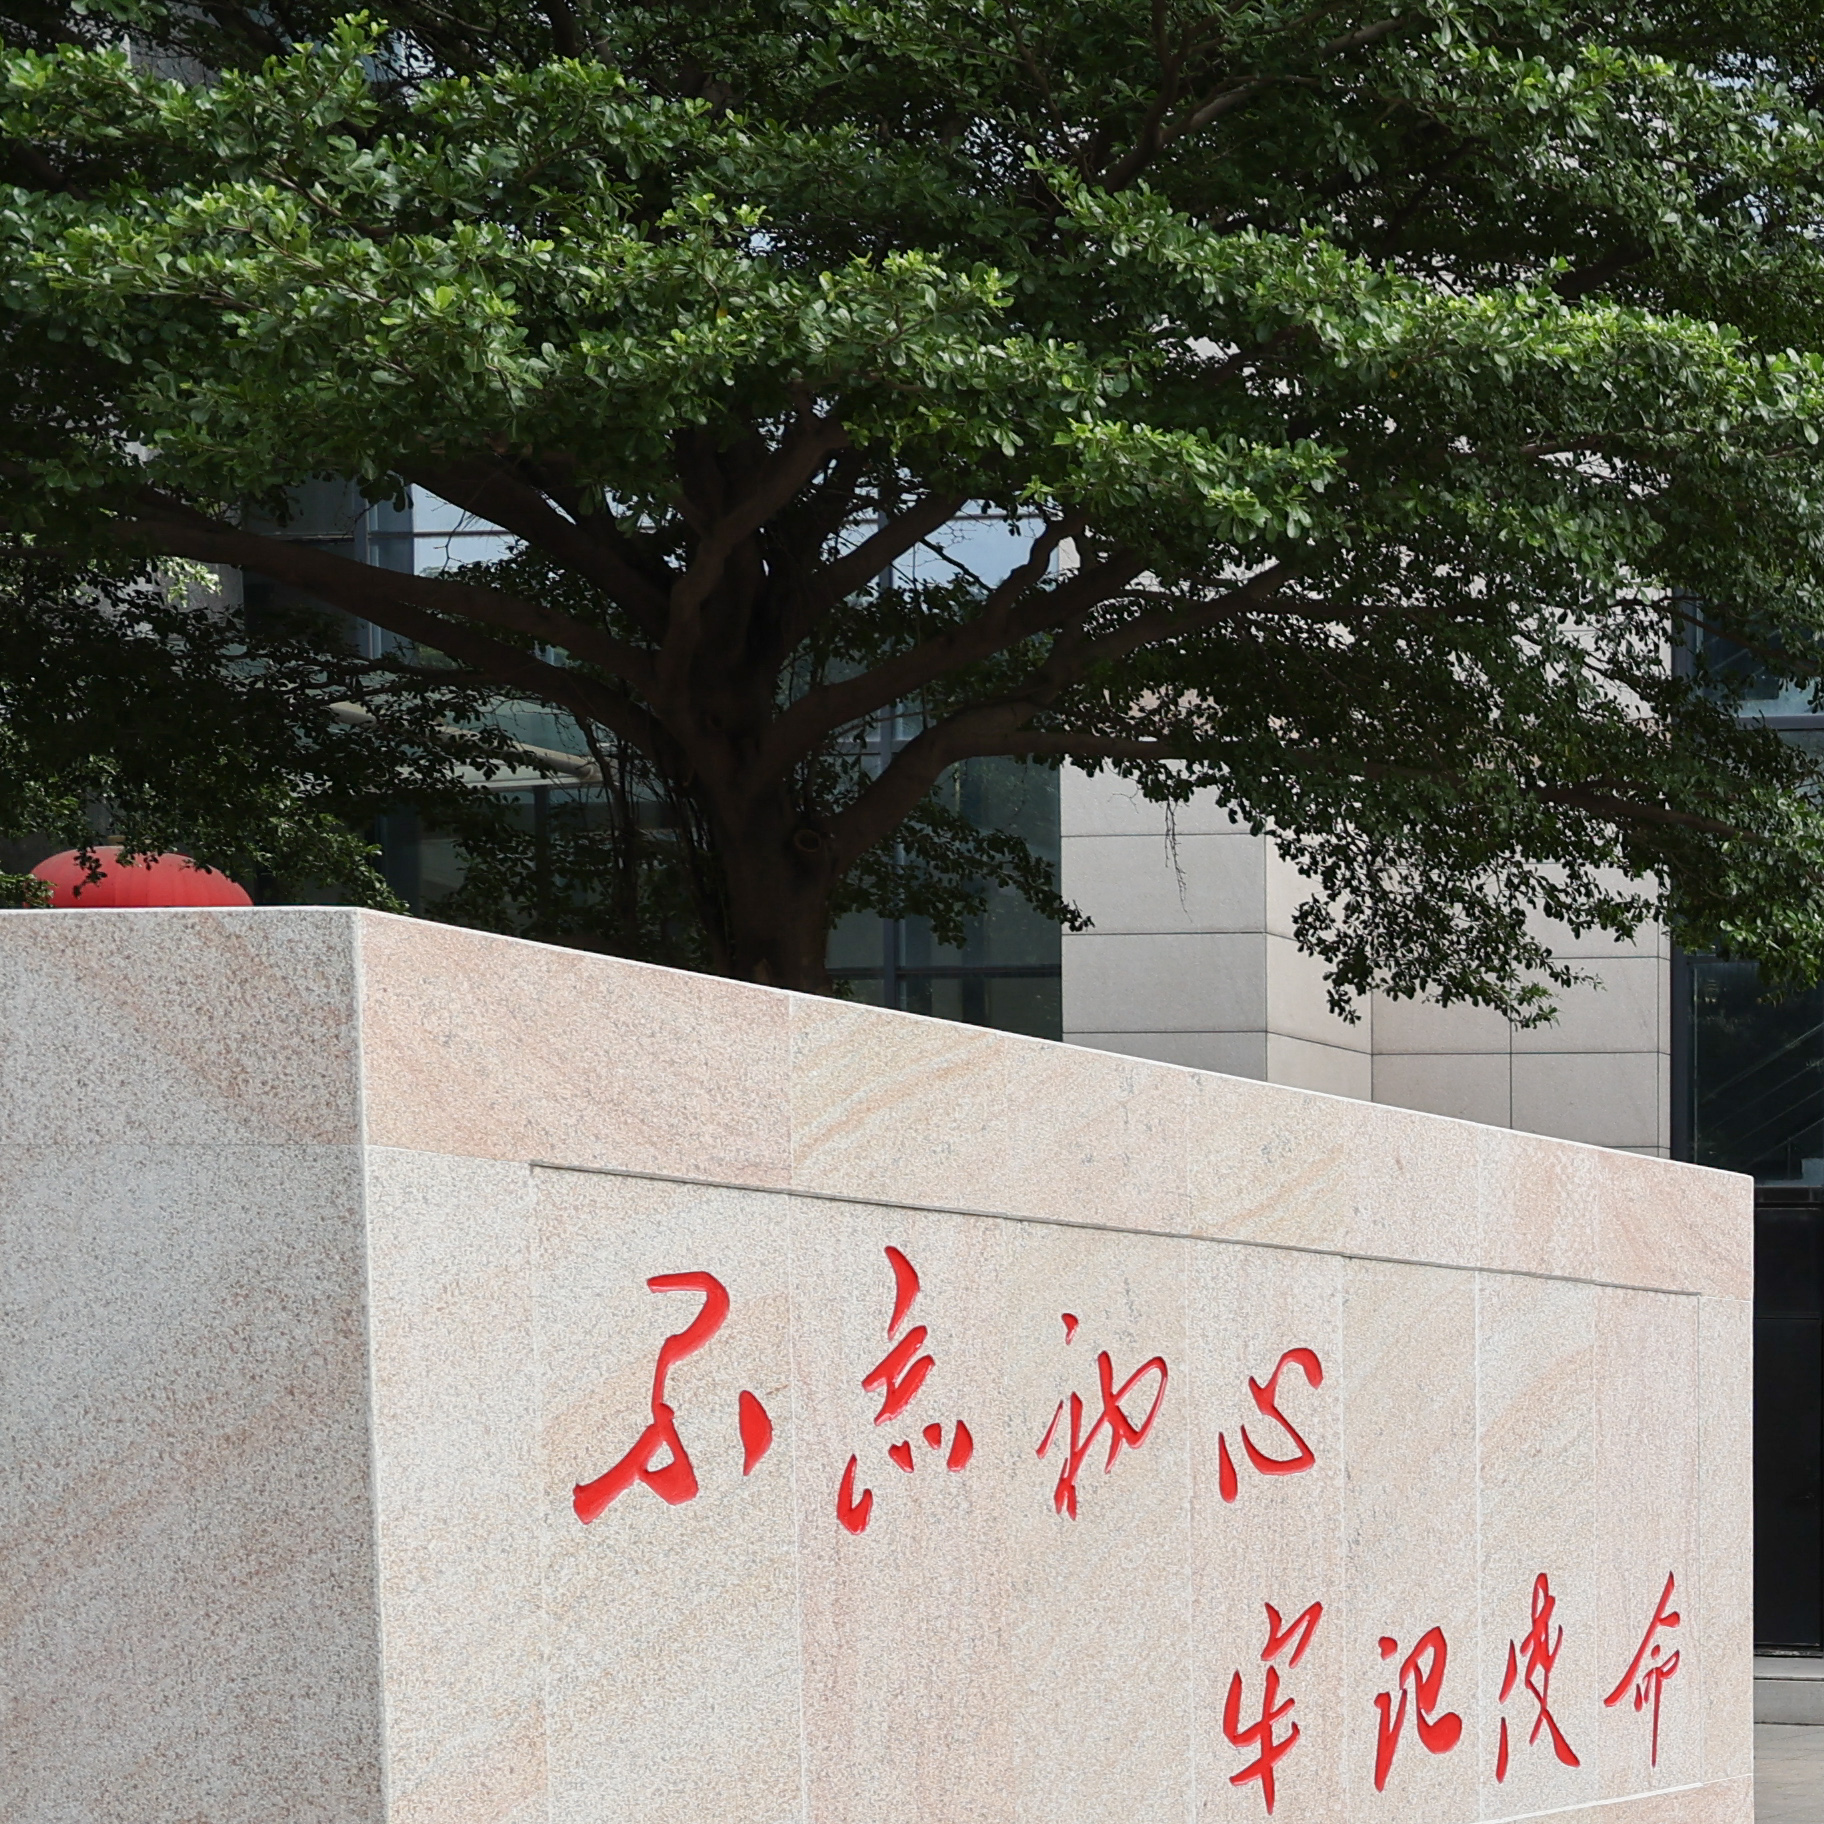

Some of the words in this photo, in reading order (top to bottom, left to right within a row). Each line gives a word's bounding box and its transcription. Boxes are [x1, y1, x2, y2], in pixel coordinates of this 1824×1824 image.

[573, 1246, 1323, 1534] 不忘初心
[1222, 1572, 1681, 1814] 牢记使命
